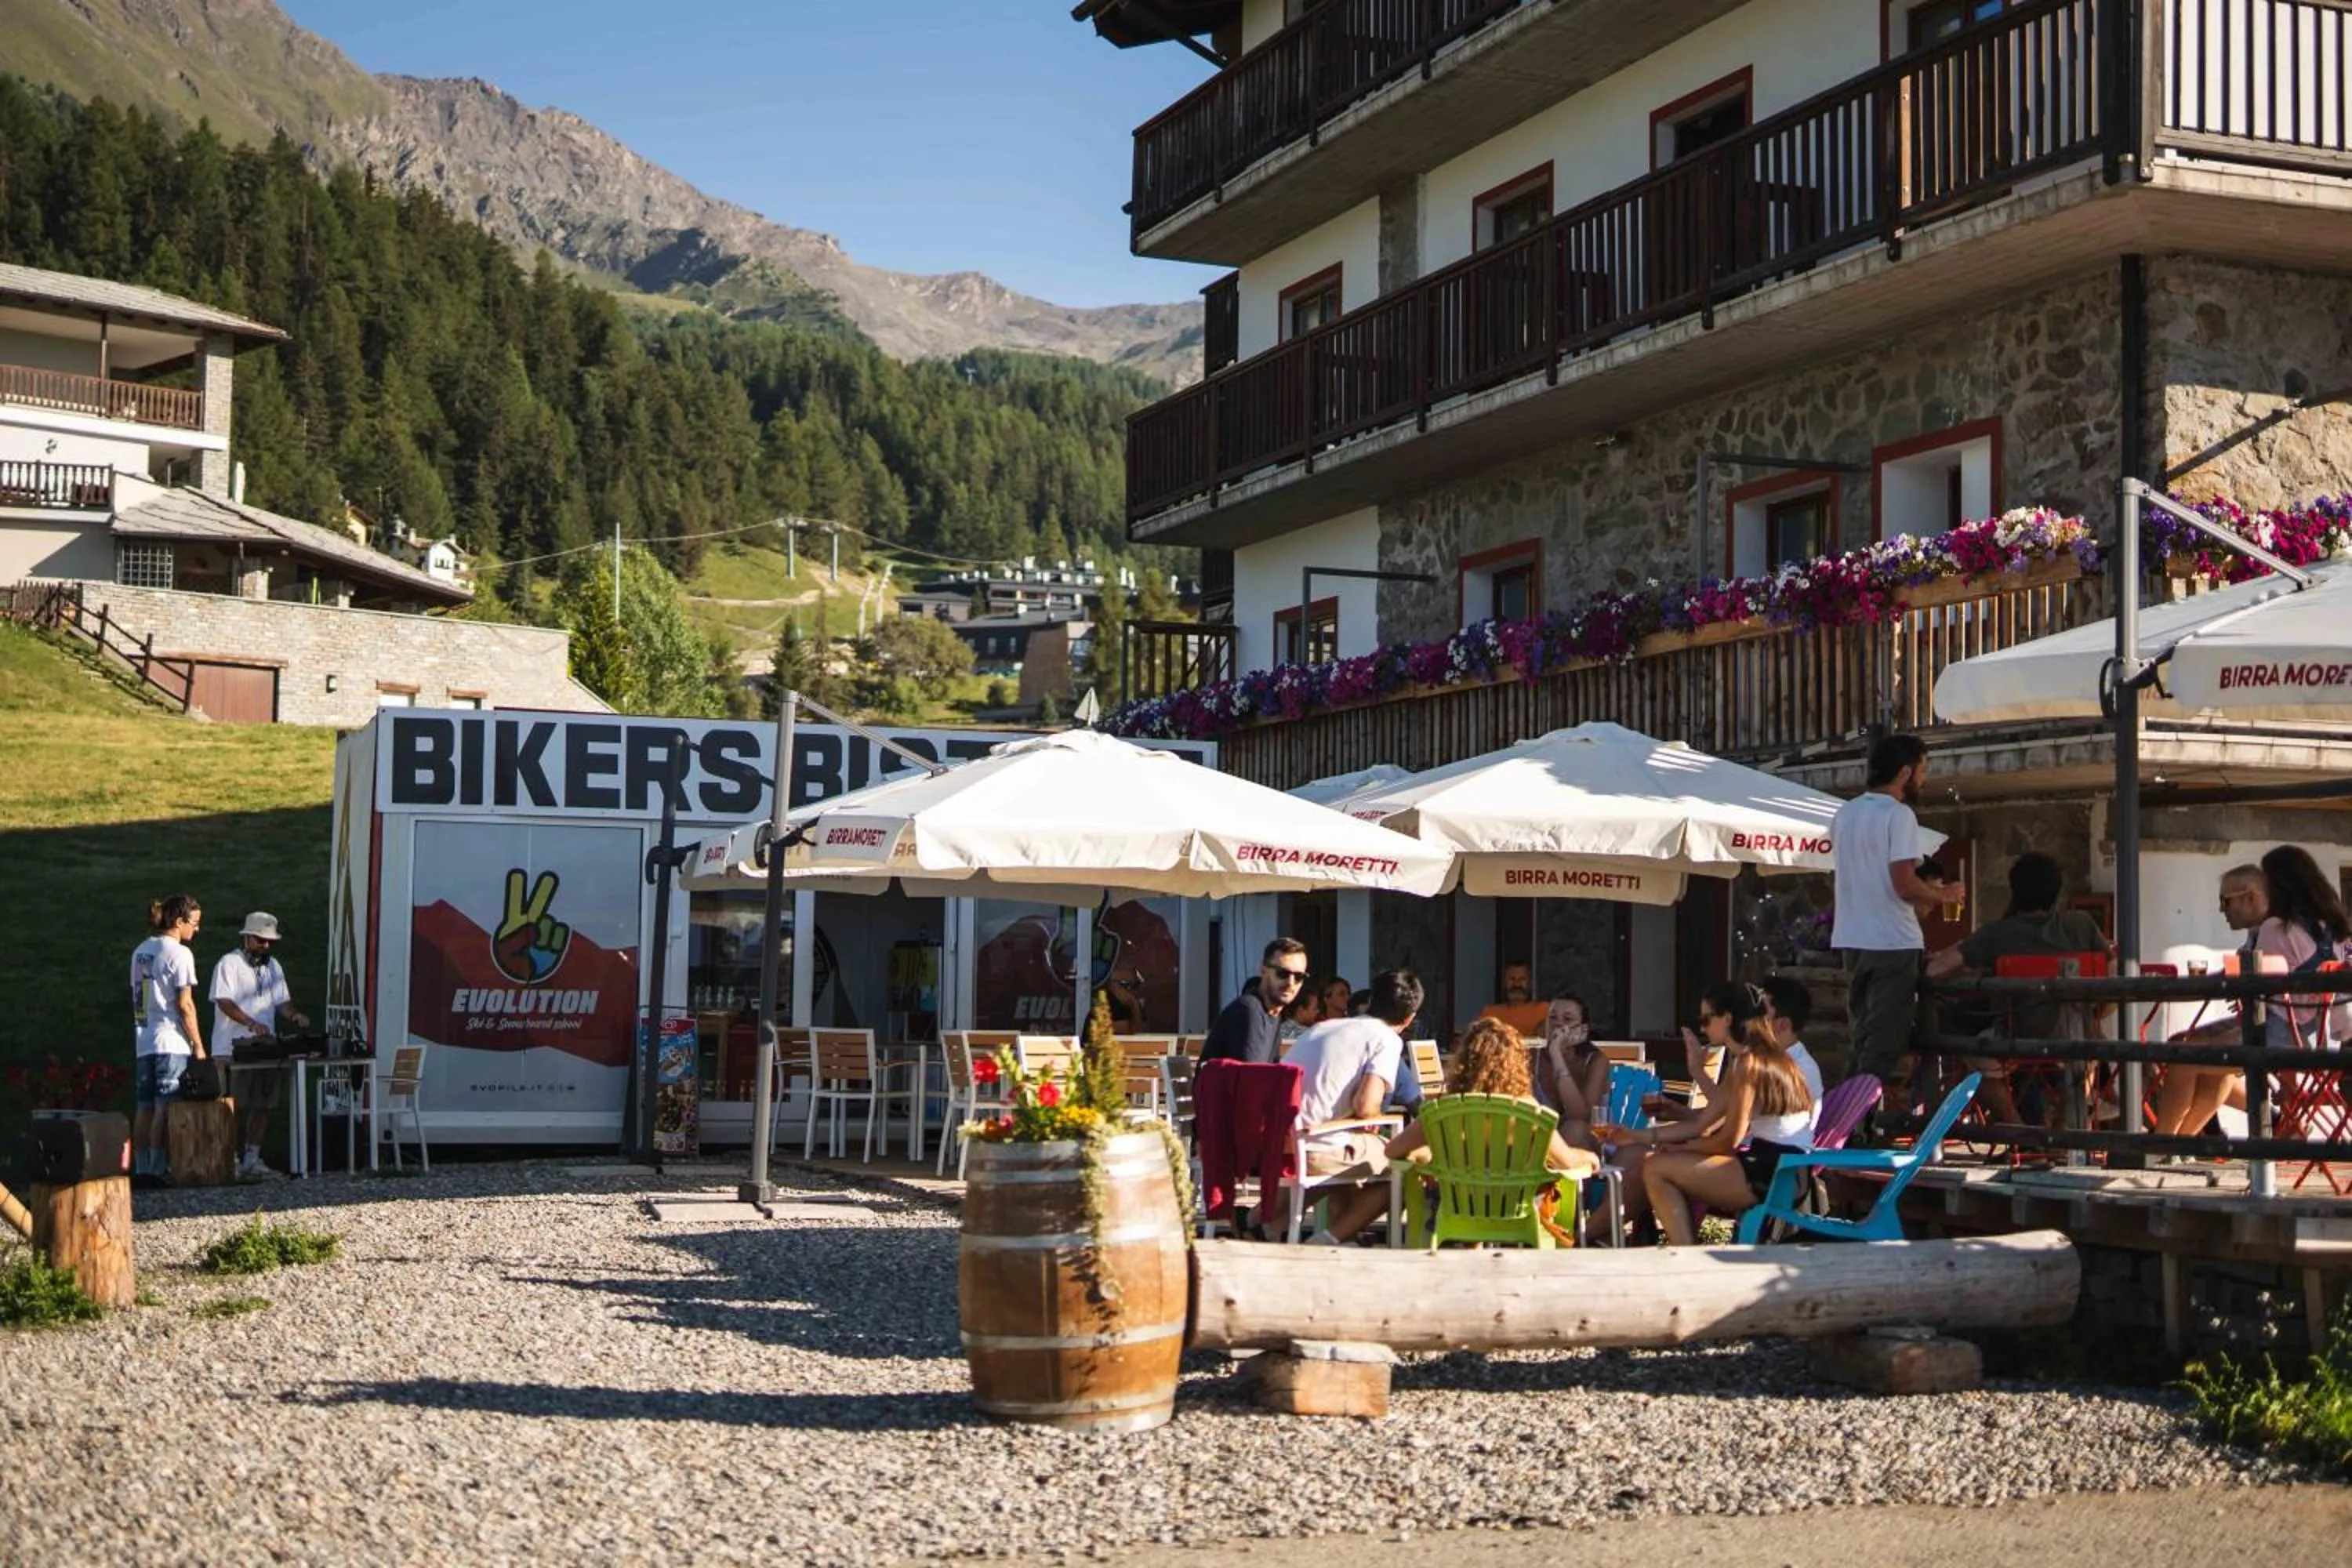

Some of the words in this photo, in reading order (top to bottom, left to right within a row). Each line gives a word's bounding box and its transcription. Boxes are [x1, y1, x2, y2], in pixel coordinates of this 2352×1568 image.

[2220, 663, 2280, 688] BIRRA
[2283, 662, 2352, 687] MORE
[391, 717, 763, 814] BIKERS
[1732, 833, 1795, 851] BIRRA
[1236, 845, 1301, 863] BIRRA
[1303, 851, 1400, 875] MORETTI
[1504, 870, 1559, 885] BIRRA
[1562, 872, 1641, 891] MORETTI
[451, 988, 600, 1014] EVOLUTION
